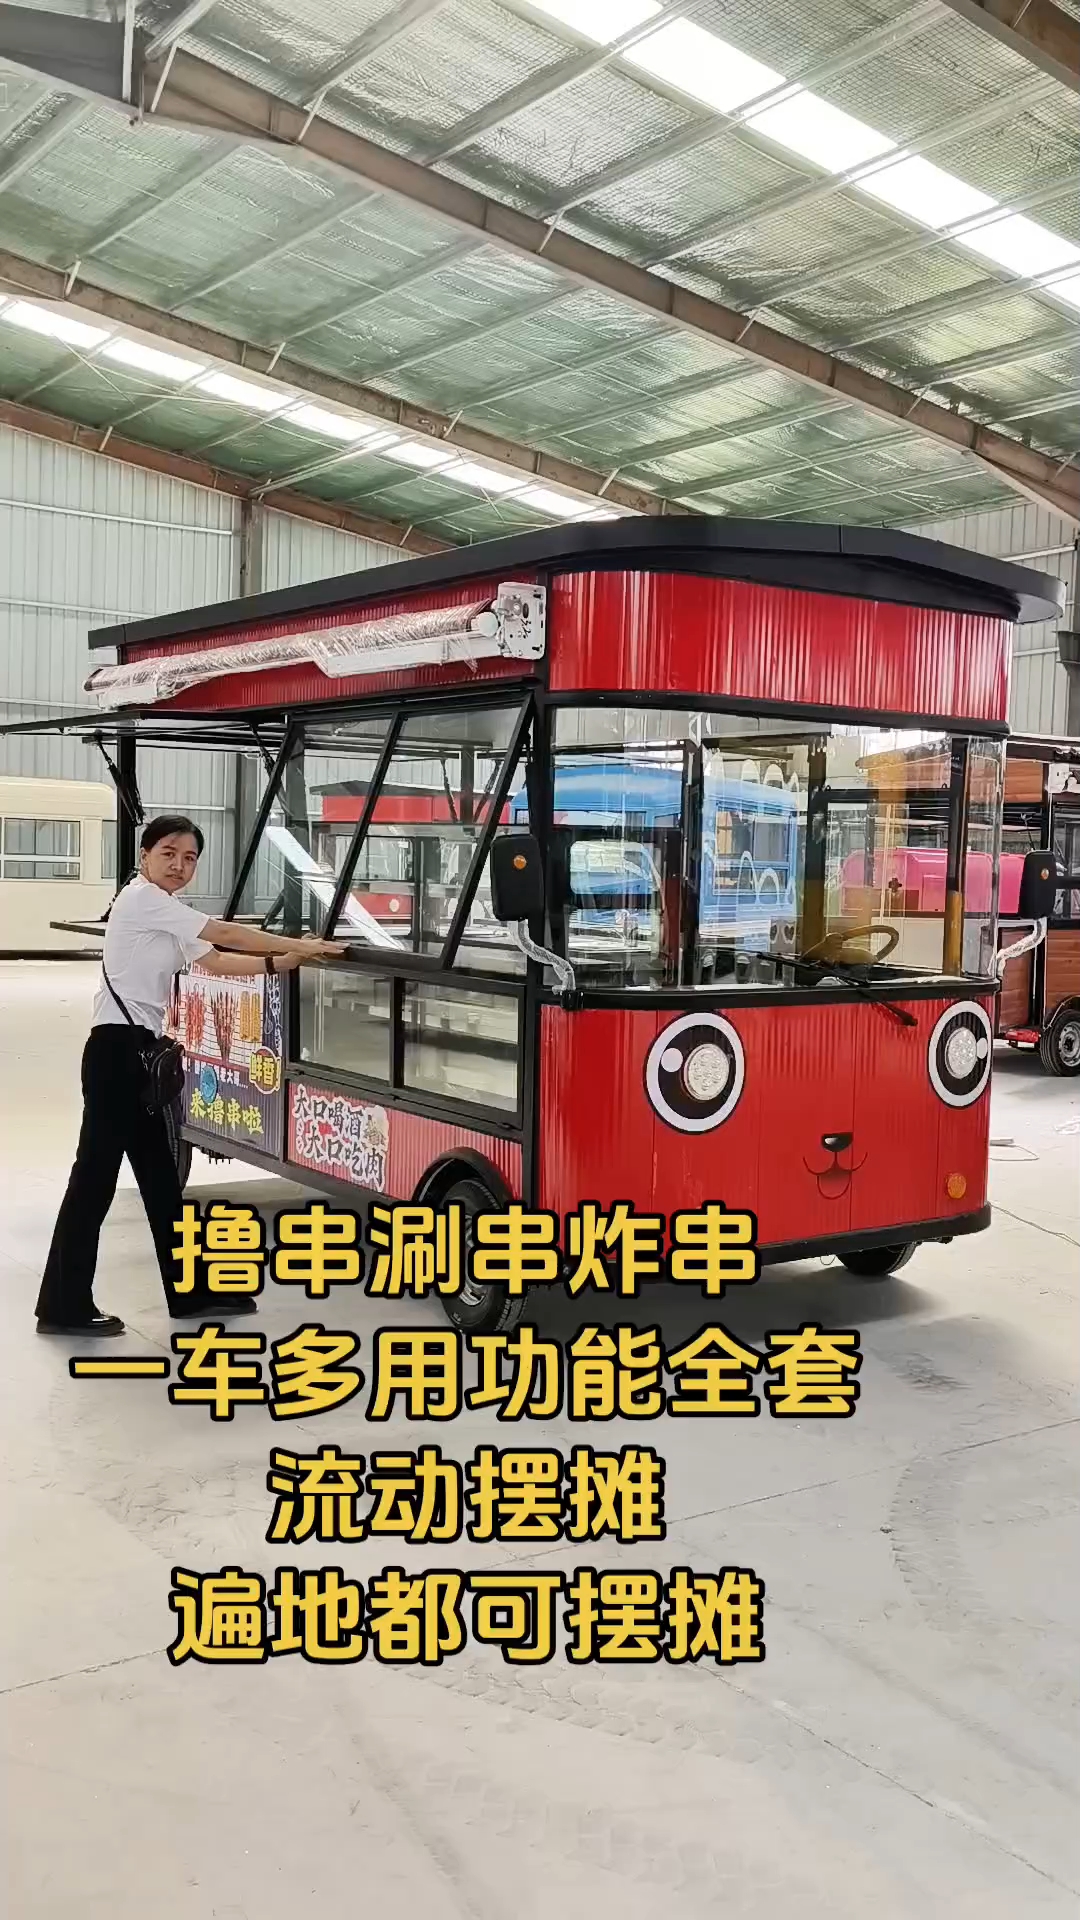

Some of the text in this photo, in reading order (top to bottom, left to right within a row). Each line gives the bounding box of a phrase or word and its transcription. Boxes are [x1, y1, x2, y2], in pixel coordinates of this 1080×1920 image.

[190, 1085, 264, 1135] 来撸串啦
[294, 1088, 364, 1140] 大口喝酒
[305, 1124, 385, 1187] 大口吃肉
